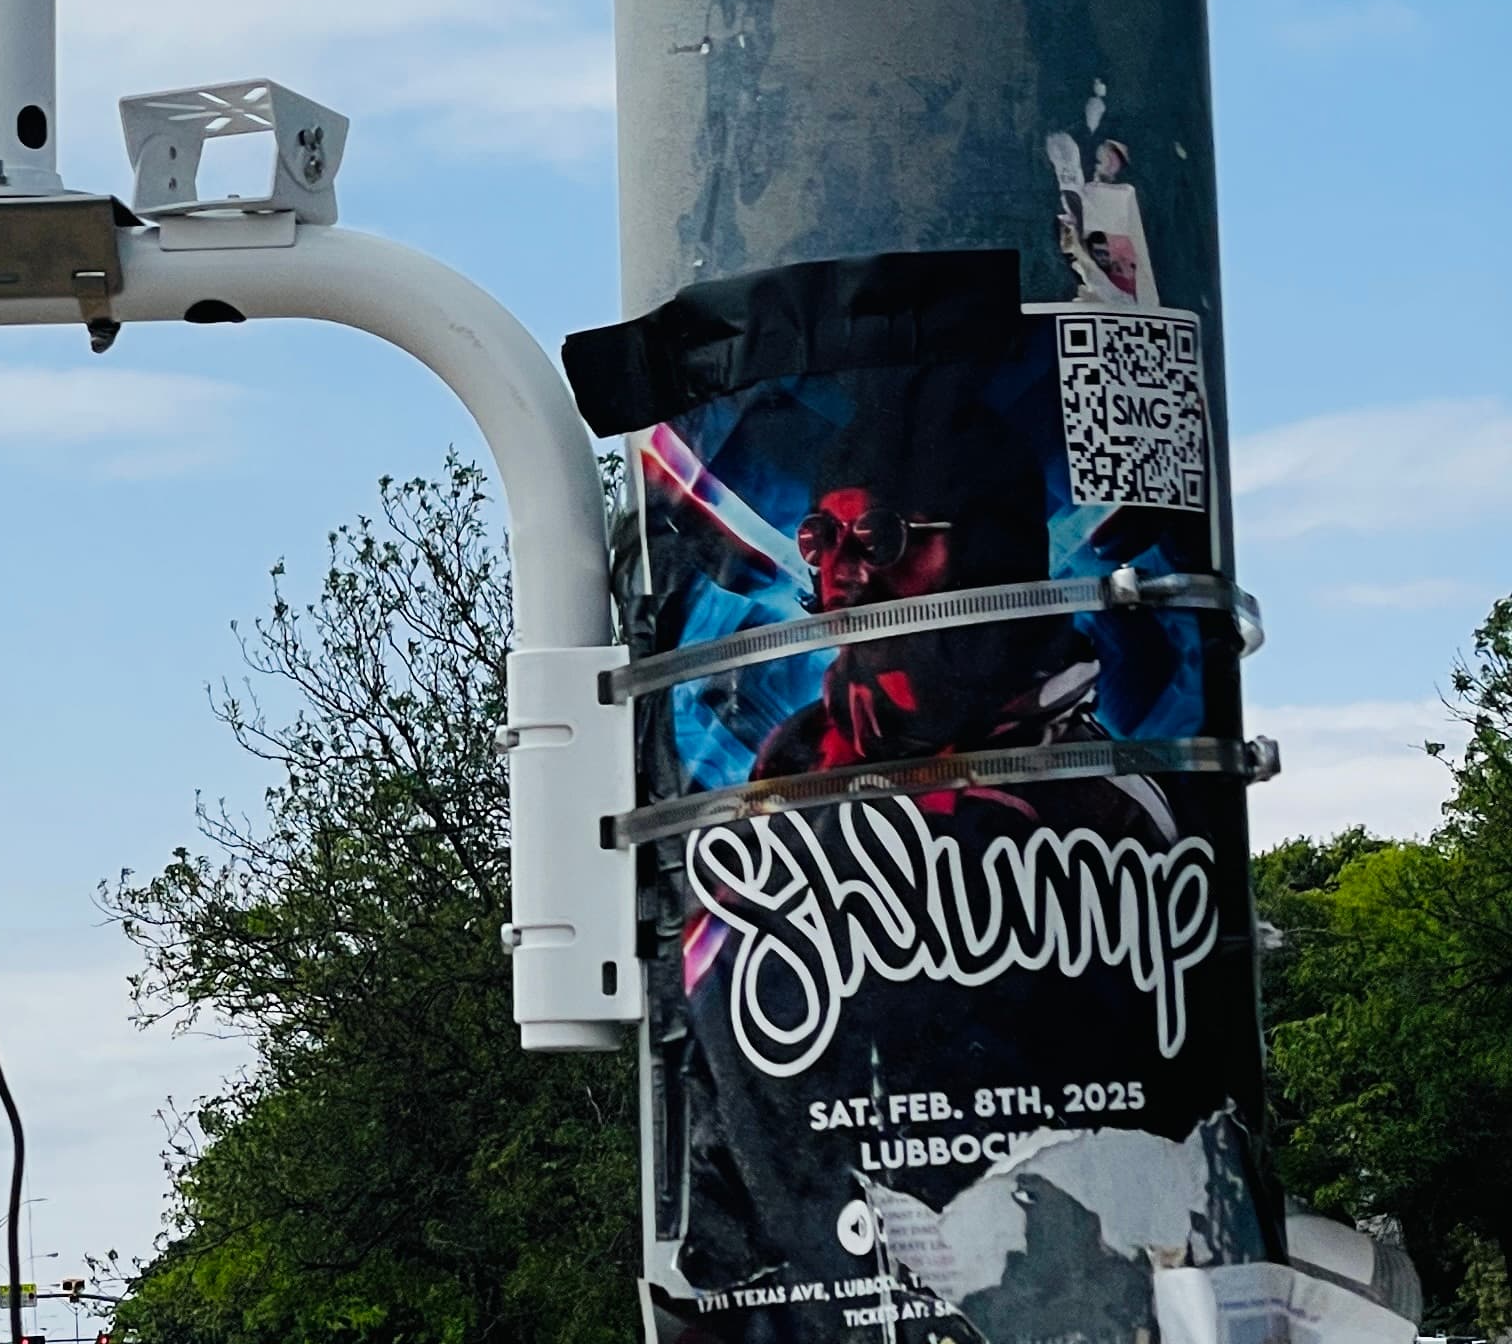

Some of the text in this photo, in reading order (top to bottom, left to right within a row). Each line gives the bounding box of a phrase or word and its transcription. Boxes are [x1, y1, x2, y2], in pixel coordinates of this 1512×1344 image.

[1113, 393, 1172, 429] SMG
[809, 1082, 1145, 1131] SAT. FEB. 8TH, 2025
[697, 1295, 729, 1313] 1711
[734, 1286, 786, 1307] TEXAS
[790, 1281, 830, 1302] AVE,
